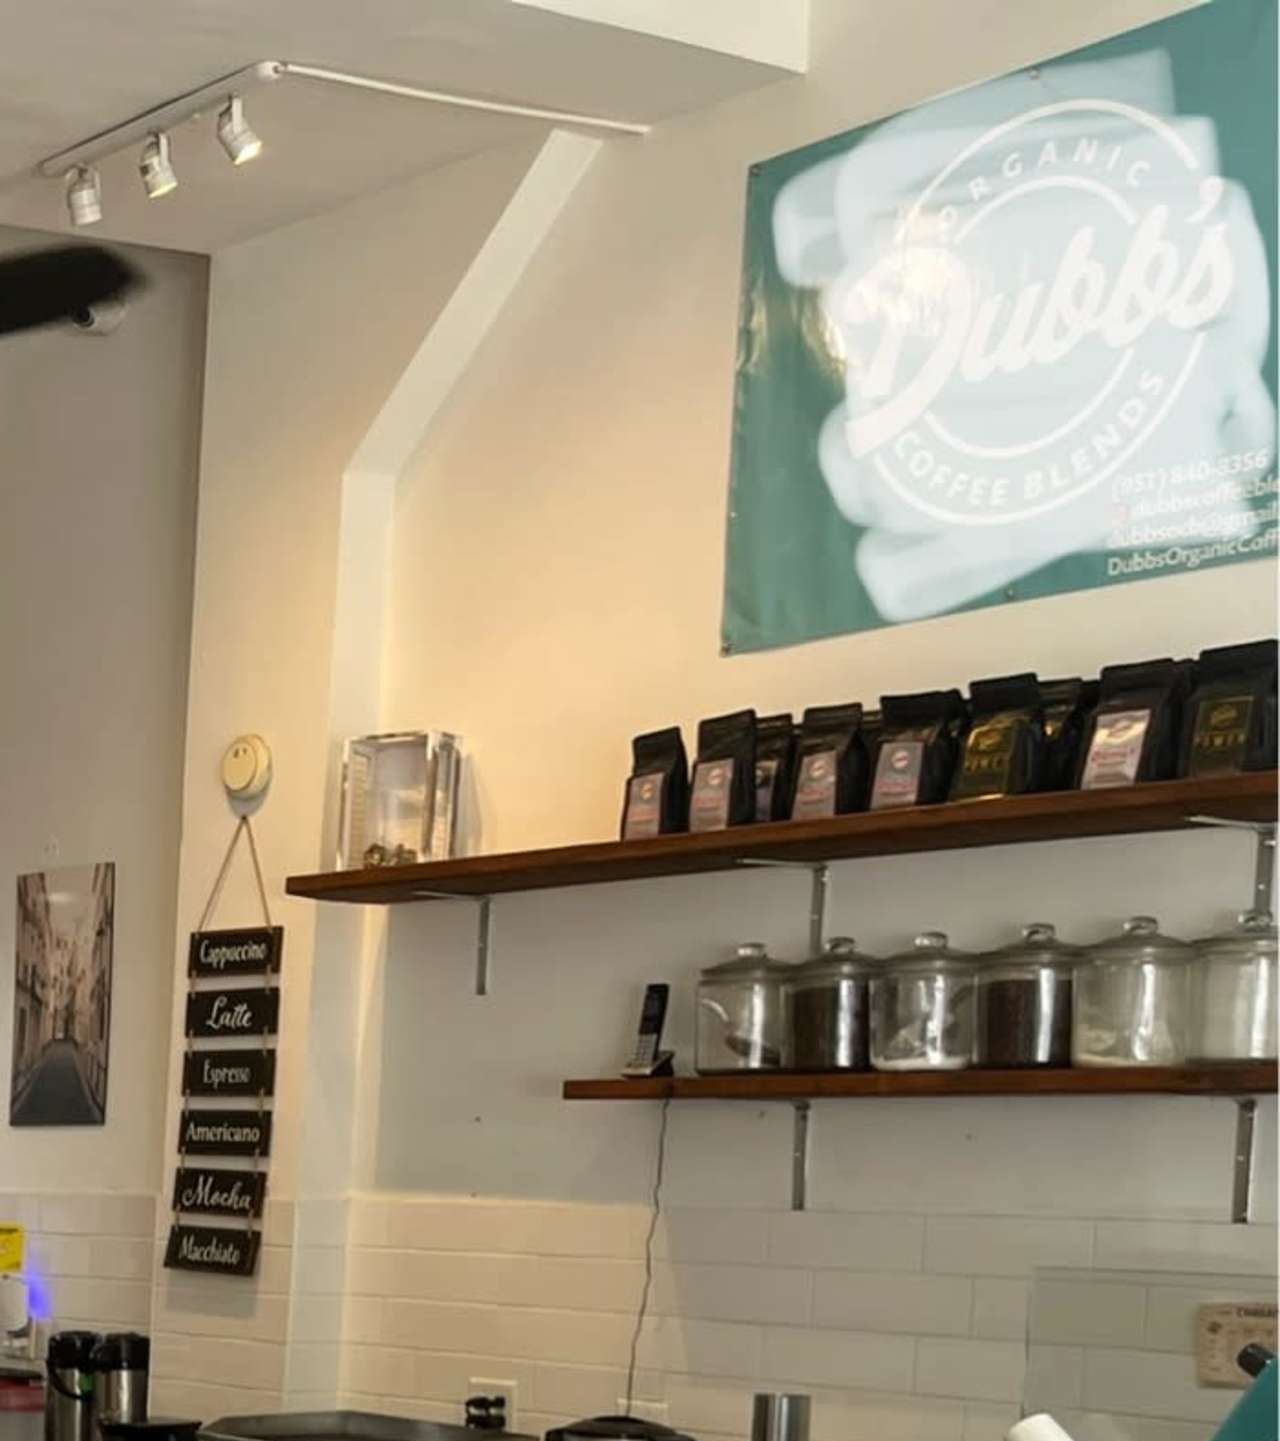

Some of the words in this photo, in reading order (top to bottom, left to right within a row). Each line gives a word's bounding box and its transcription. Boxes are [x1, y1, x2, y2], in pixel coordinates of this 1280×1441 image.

[939, 136, 1152, 232] ORGANIC
[825, 175, 1235, 459] Dubb's
[894, 429, 1007, 507] COFFEE
[1023, 368, 1166, 500] BLENDS
[199, 939, 268, 972] Cappuccino
[205, 996, 253, 1030] Latte
[203, 1059, 251, 1085] Espresso
[185, 1121, 260, 1145] Americano
[181, 1175, 252, 1210] Mocha
[178, 1235, 241, 1267] Macchiato
